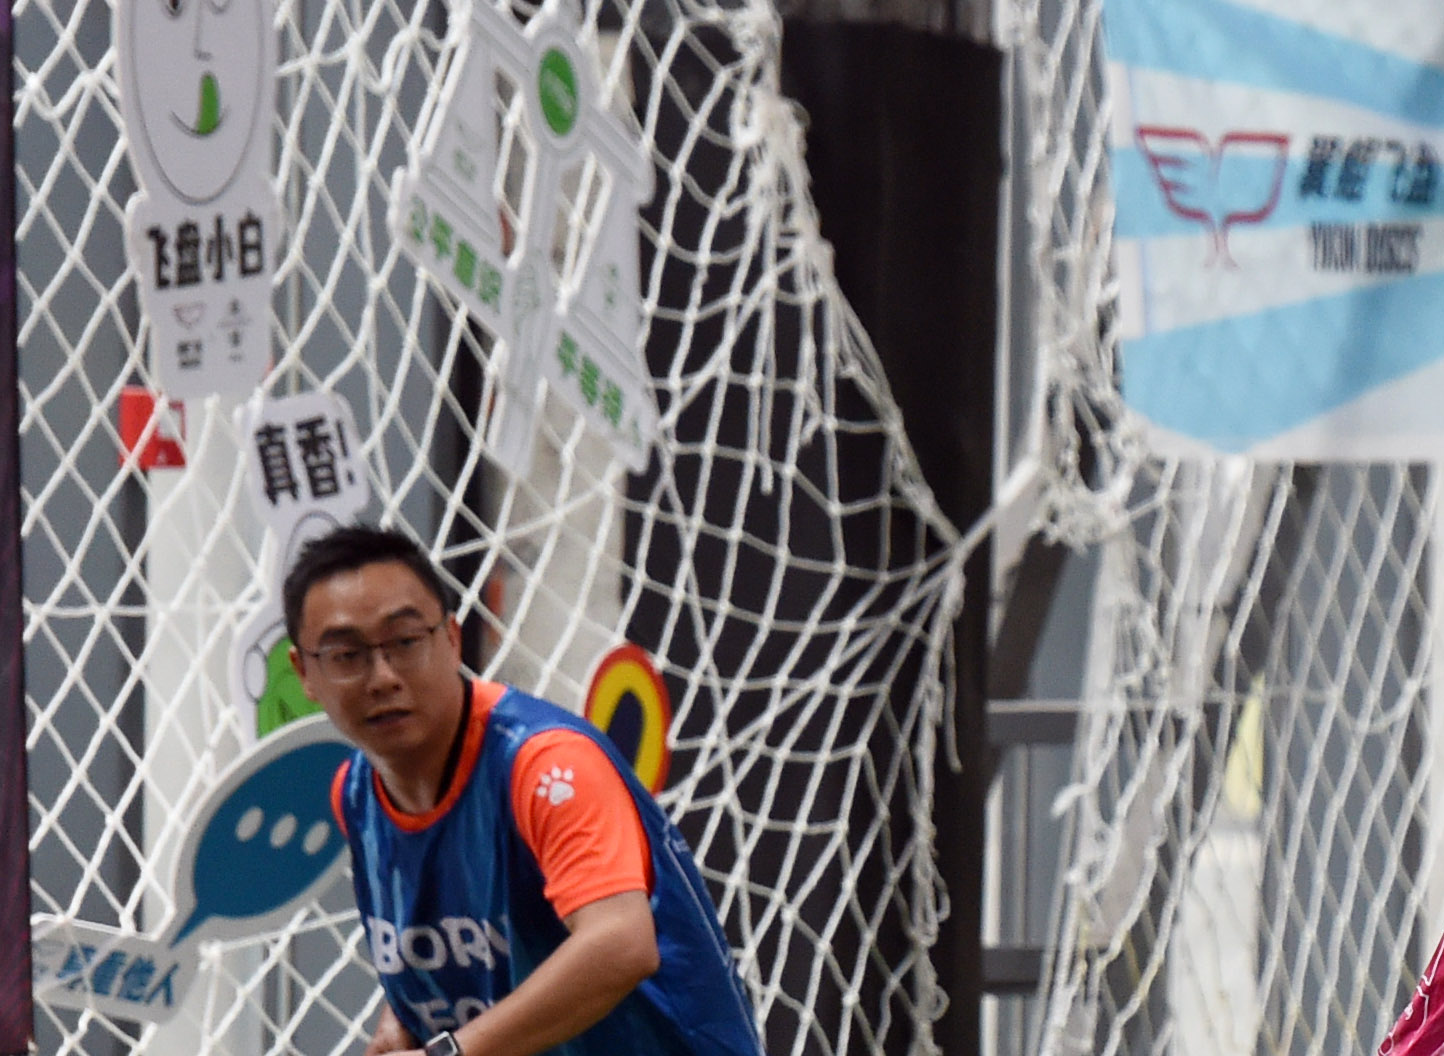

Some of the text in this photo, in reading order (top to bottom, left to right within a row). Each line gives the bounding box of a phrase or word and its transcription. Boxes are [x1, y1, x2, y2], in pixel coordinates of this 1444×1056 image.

[147, 210, 264, 290] 飞盘小白
[255, 415, 354, 506] 真香!
